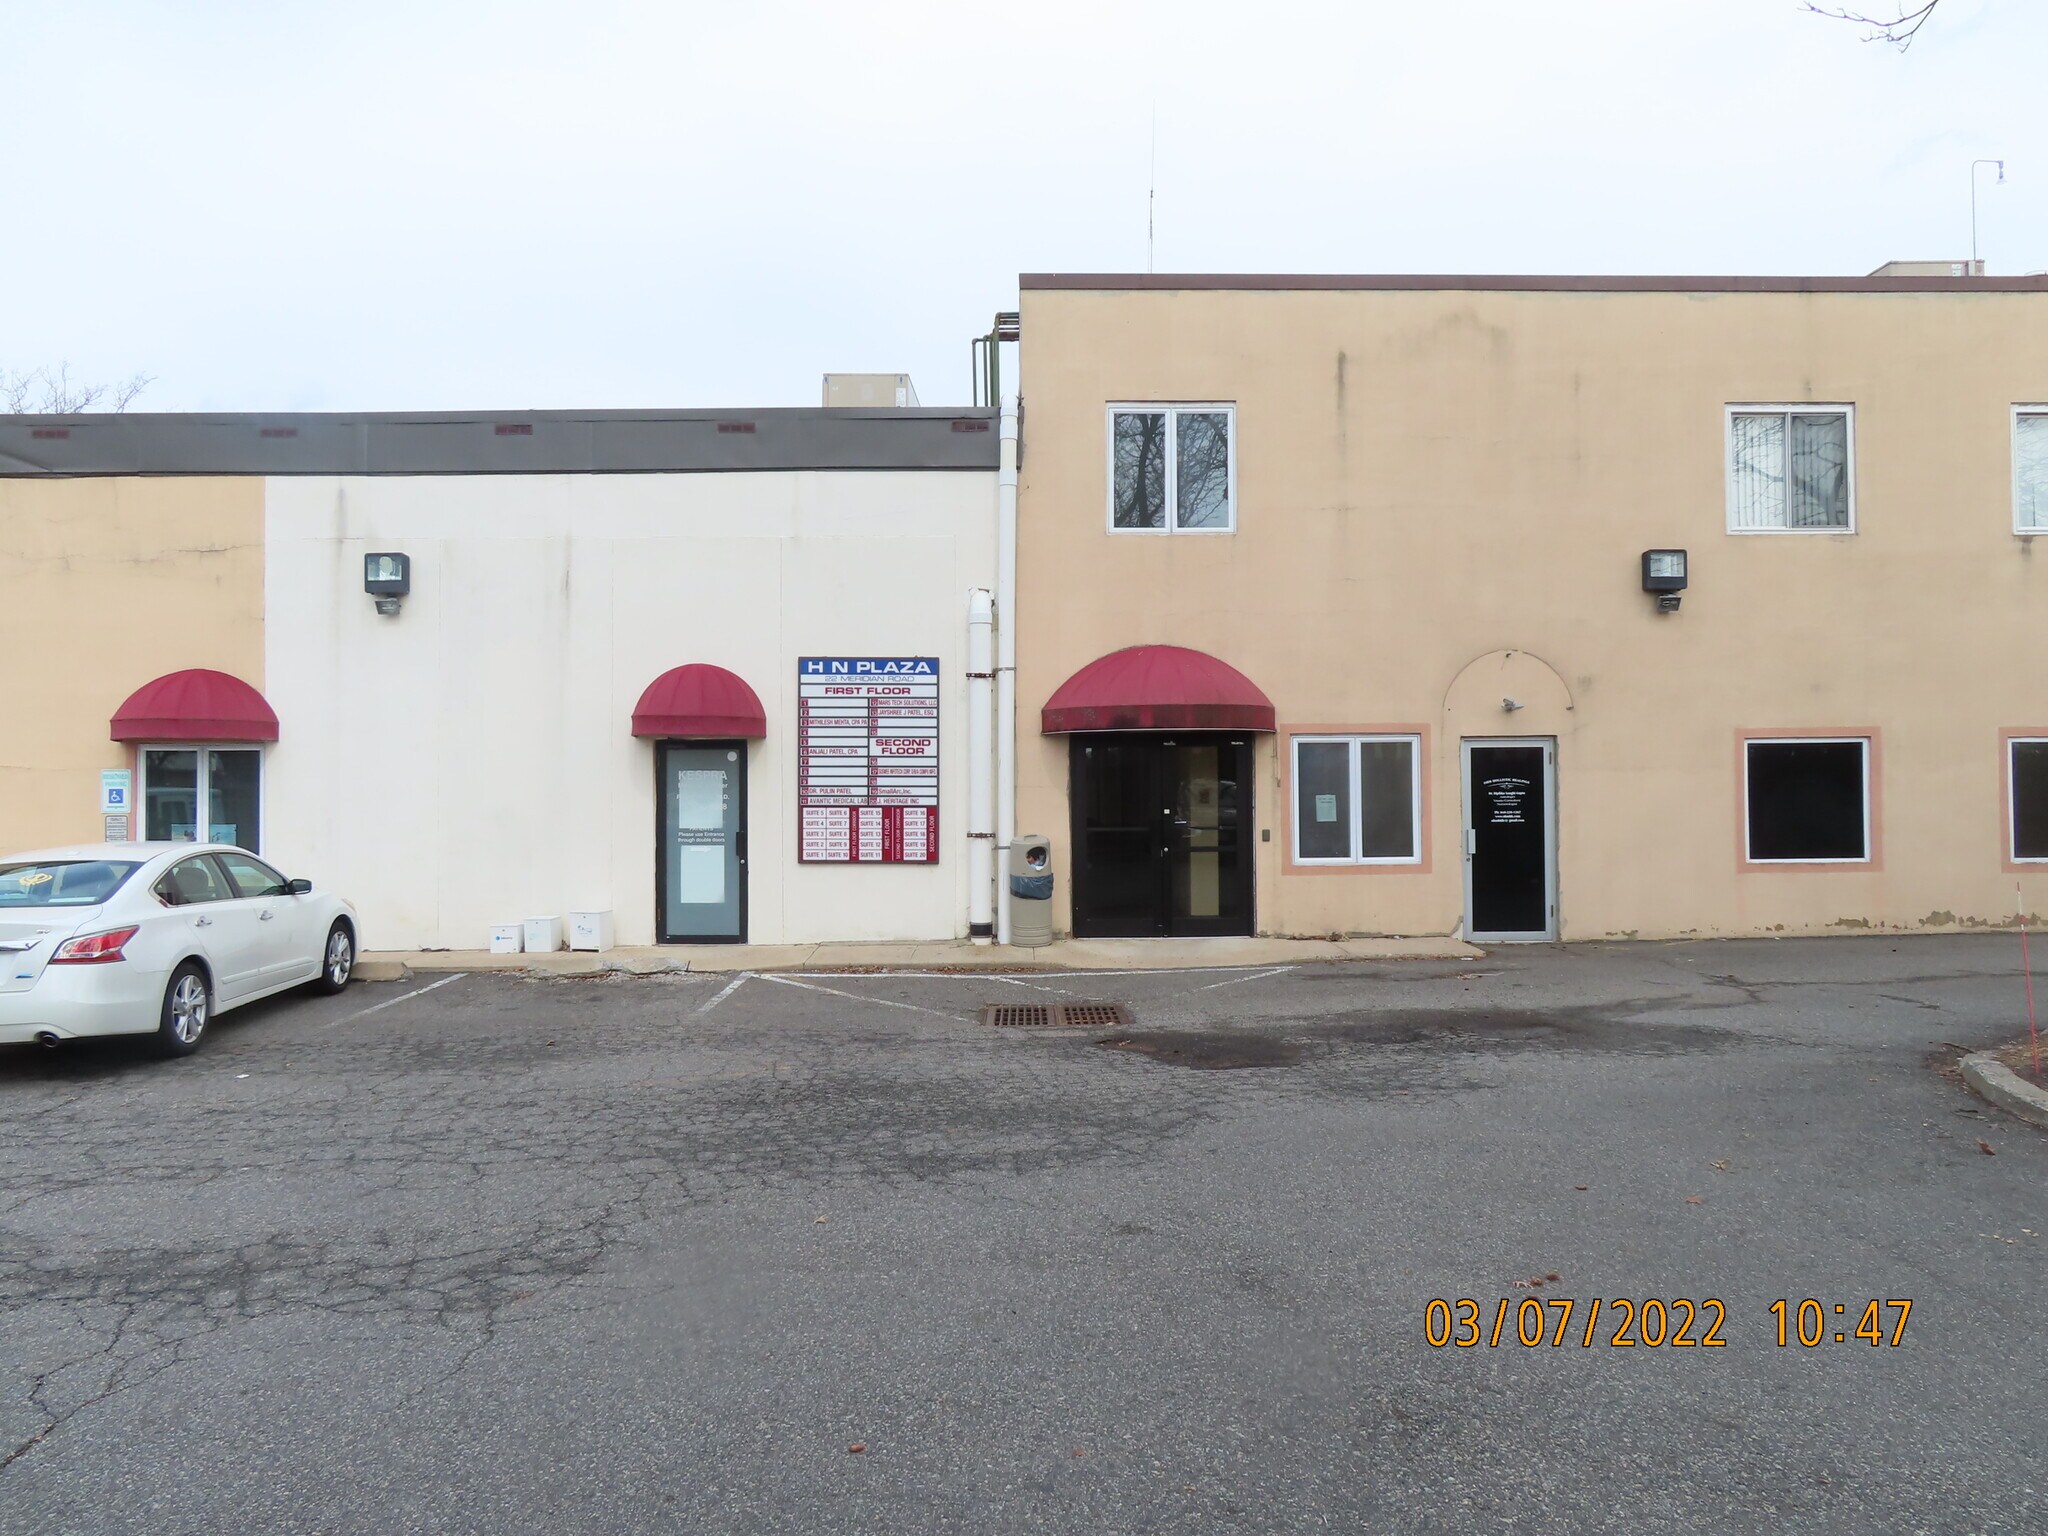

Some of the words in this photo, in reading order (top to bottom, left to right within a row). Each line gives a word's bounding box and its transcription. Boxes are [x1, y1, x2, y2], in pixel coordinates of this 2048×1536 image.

[808, 661, 824, 673] H
[832, 661, 848, 673] N
[856, 661, 932, 674] PLAZA
[824, 686, 862, 695] FIRST
[866, 686, 911, 695] FLOOR
